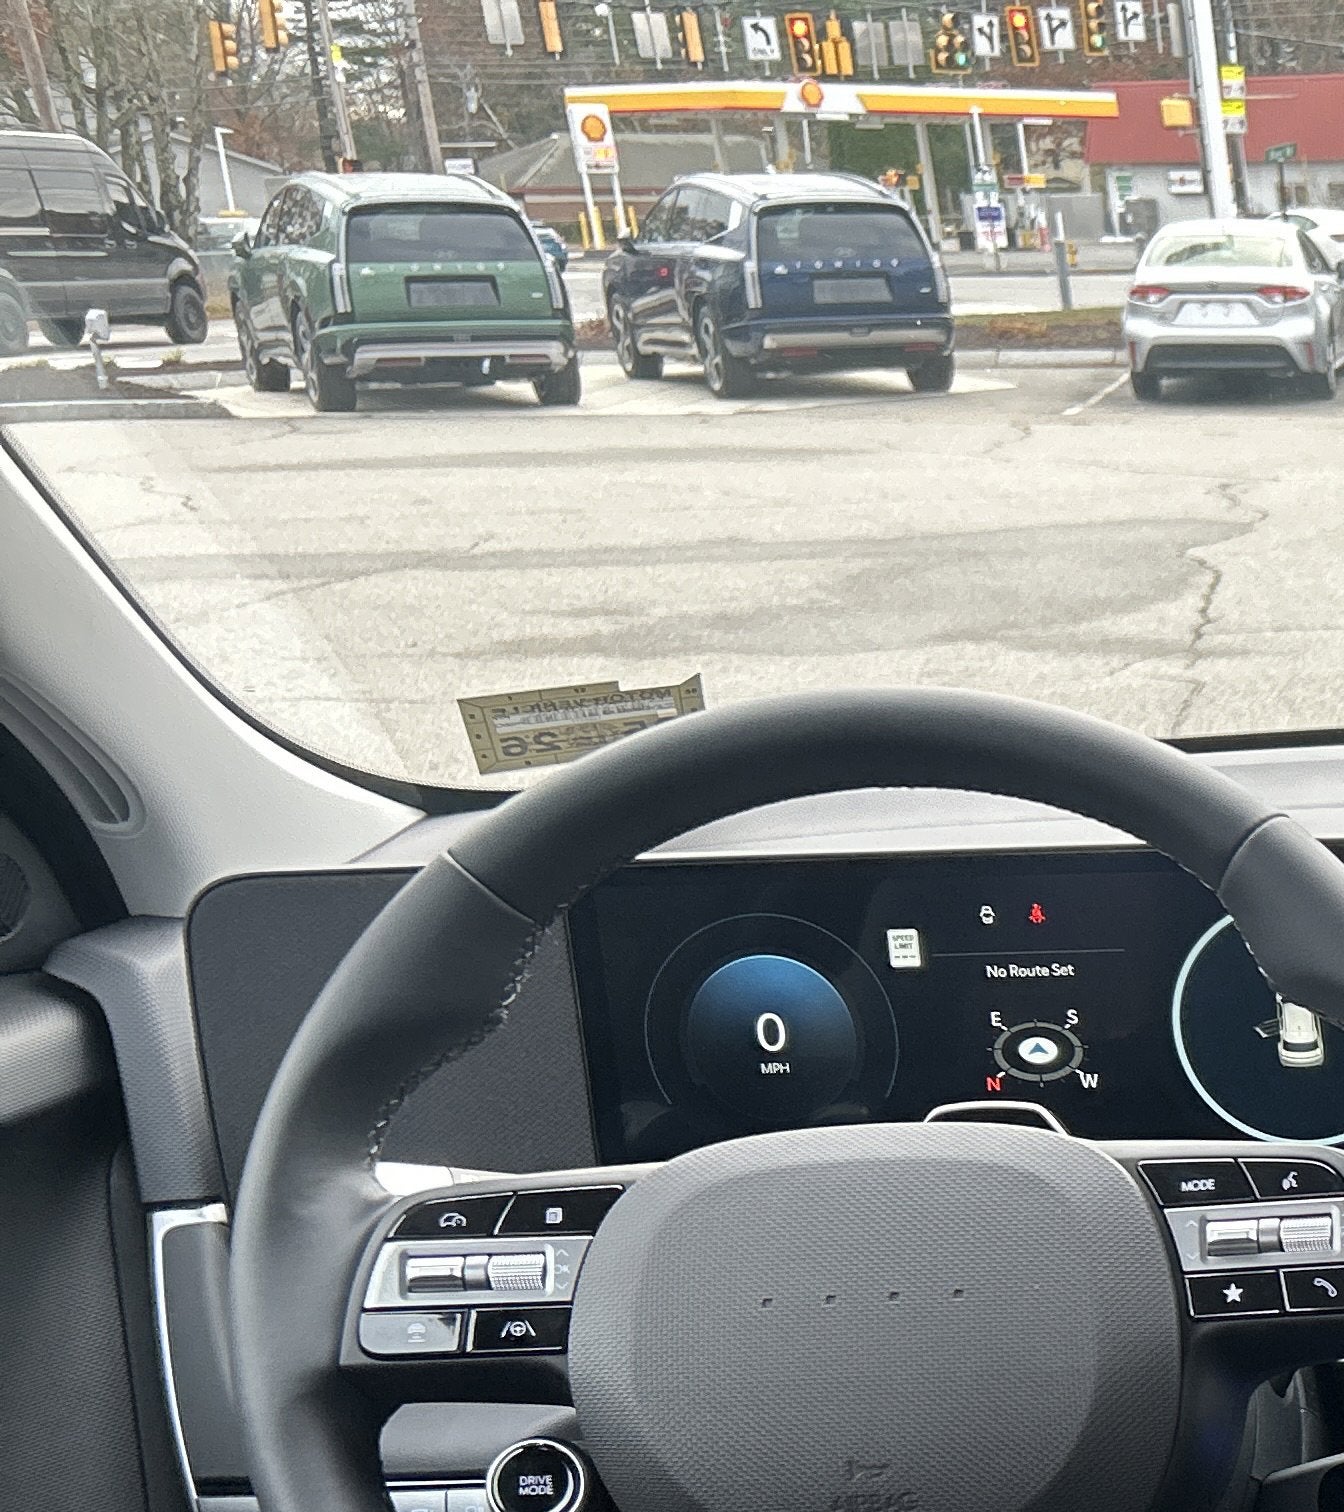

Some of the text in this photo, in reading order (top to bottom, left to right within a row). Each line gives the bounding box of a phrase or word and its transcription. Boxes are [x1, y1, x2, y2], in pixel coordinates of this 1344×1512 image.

[891, 933, 915, 944] SPEED
[985, 963, 1076, 979] No Route Set
[990, 1010, 1003, 1026] E
[1066, 1009, 1079, 1026] S
[755, 1011, 788, 1053] 0
[760, 1061, 791, 1076] MPH
[986, 1076, 1001, 1092] N
[1079, 1073, 1099, 1090] W
[1180, 1178, 1217, 1193] MODE
[518, 1474, 553, 1487] DRIVE
[518, 1485, 554, 1497] MODE
